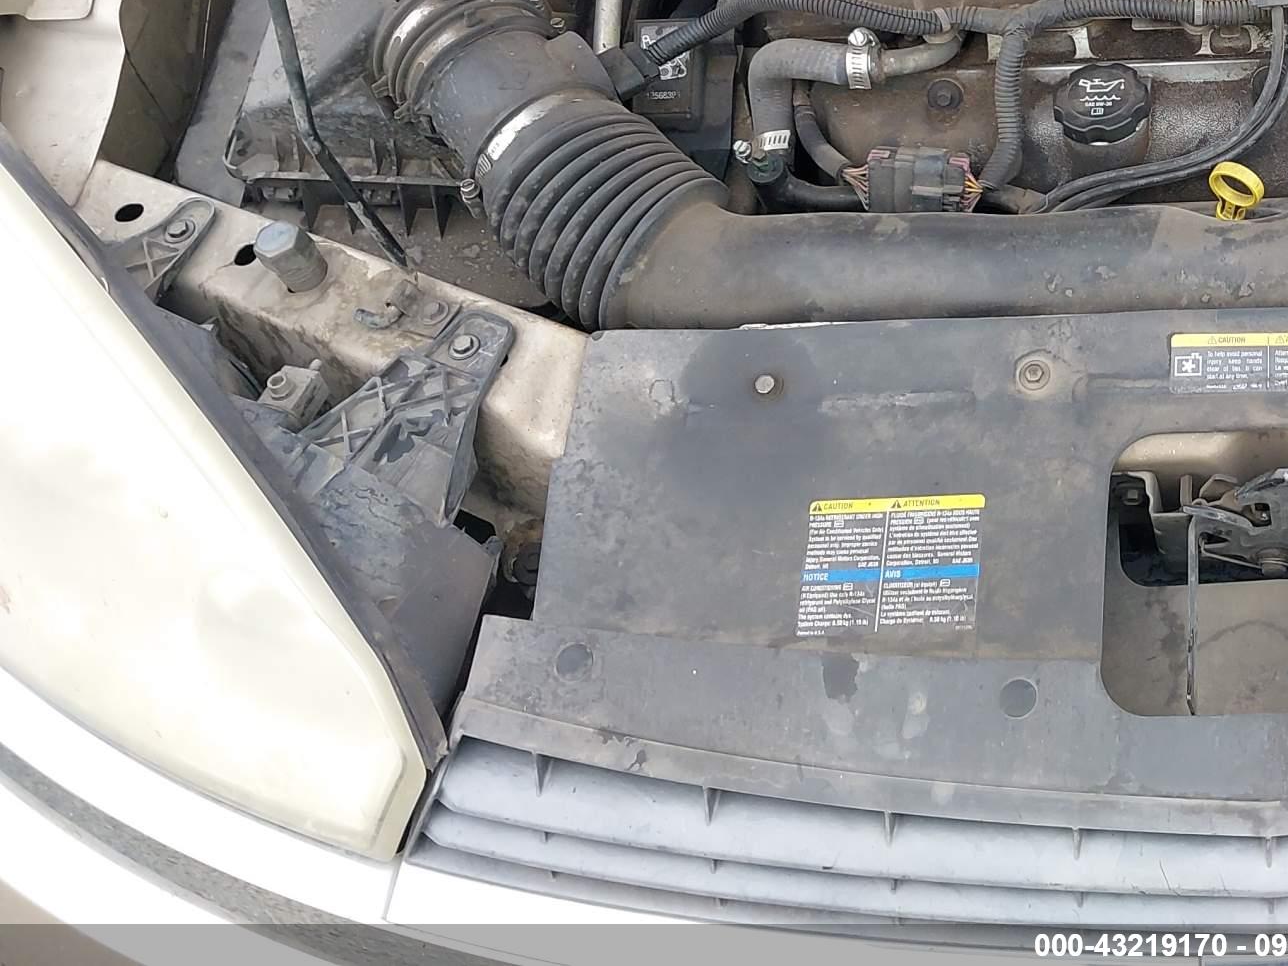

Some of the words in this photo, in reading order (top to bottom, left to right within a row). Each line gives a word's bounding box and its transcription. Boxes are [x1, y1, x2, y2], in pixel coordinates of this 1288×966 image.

[823, 502, 853, 510] CAUTION
[903, 499, 940, 507] ATTENTION
[803, 573, 829, 581] NOTICE
[885, 570, 901, 578] AVIS
